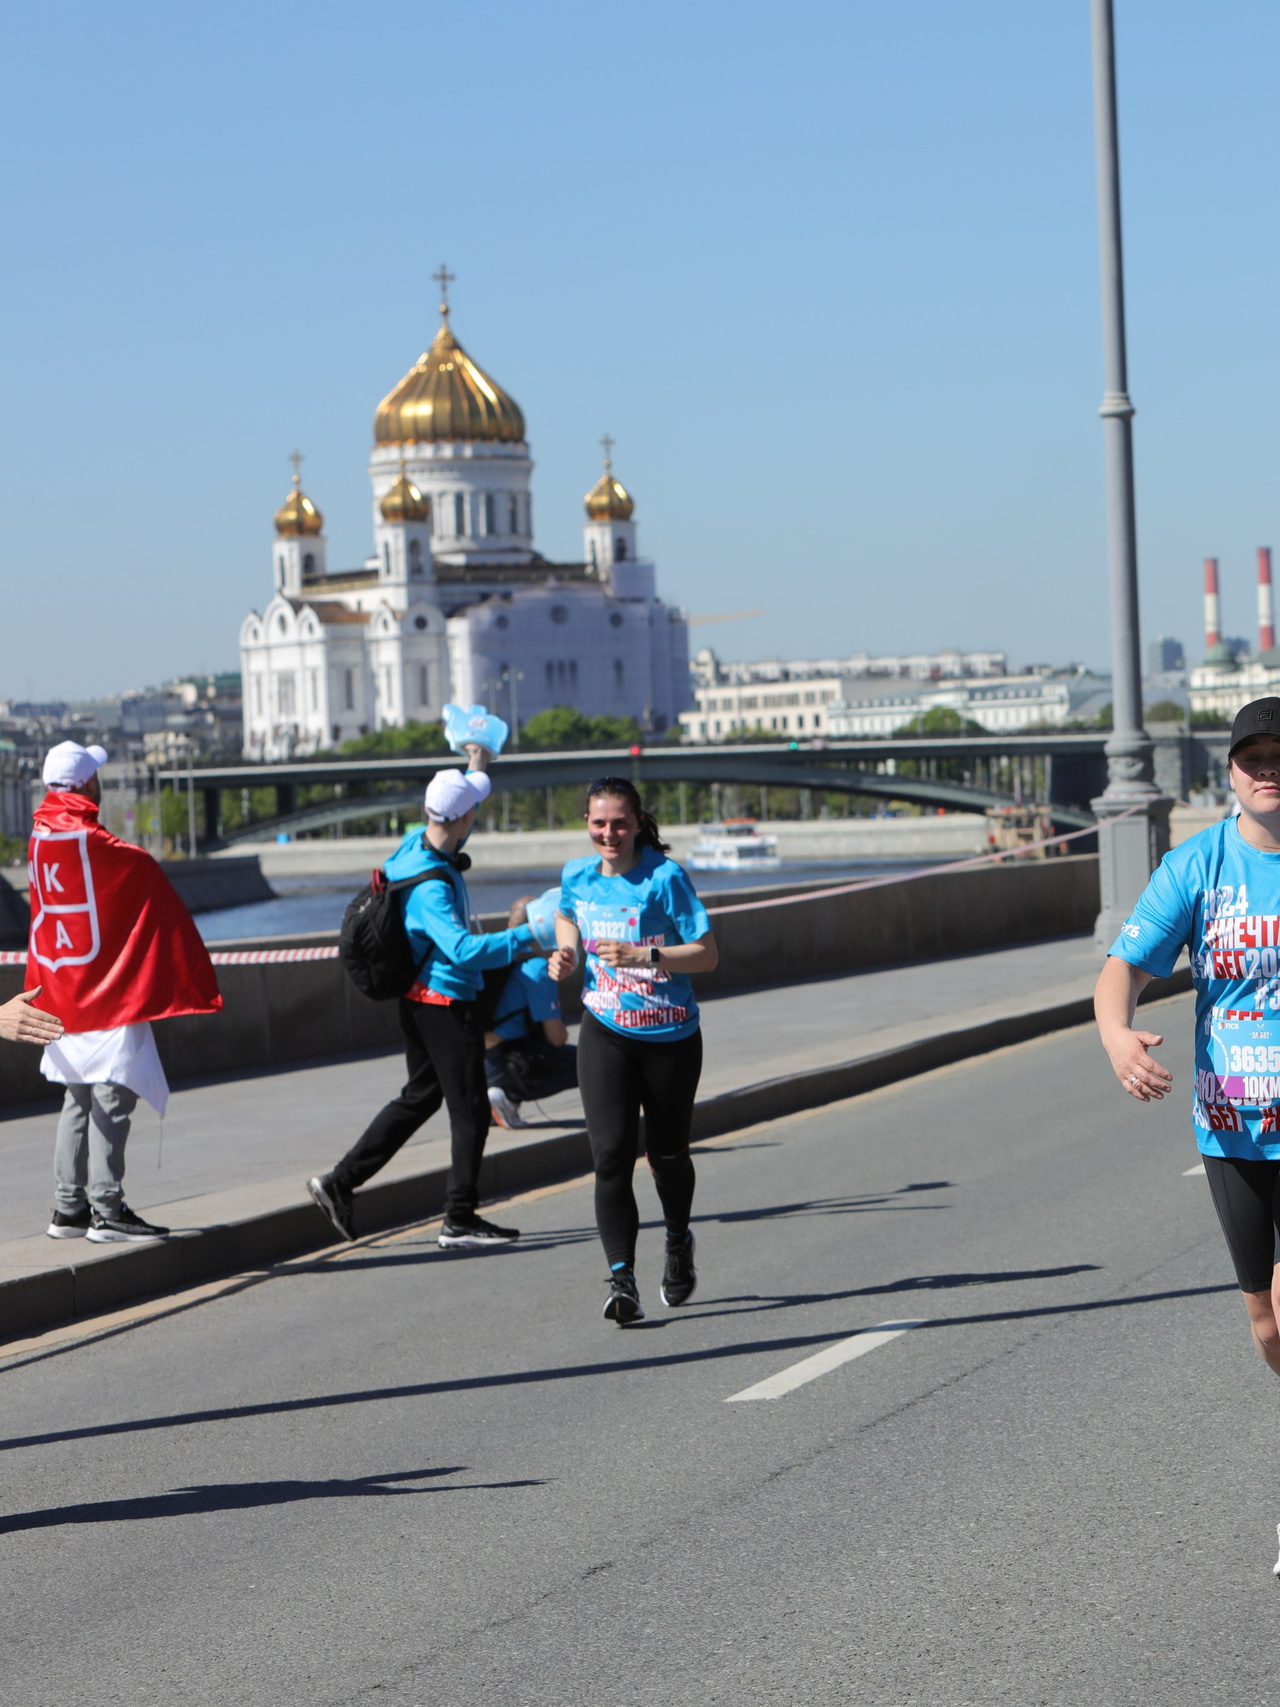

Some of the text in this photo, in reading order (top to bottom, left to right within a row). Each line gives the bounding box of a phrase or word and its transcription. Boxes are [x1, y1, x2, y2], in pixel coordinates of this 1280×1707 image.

[592, 920, 626, 939] 33127
[613, 1006, 688, 1028] #ЕДИНСТВО
[1225, 1022, 1239, 1030] ПСБ
